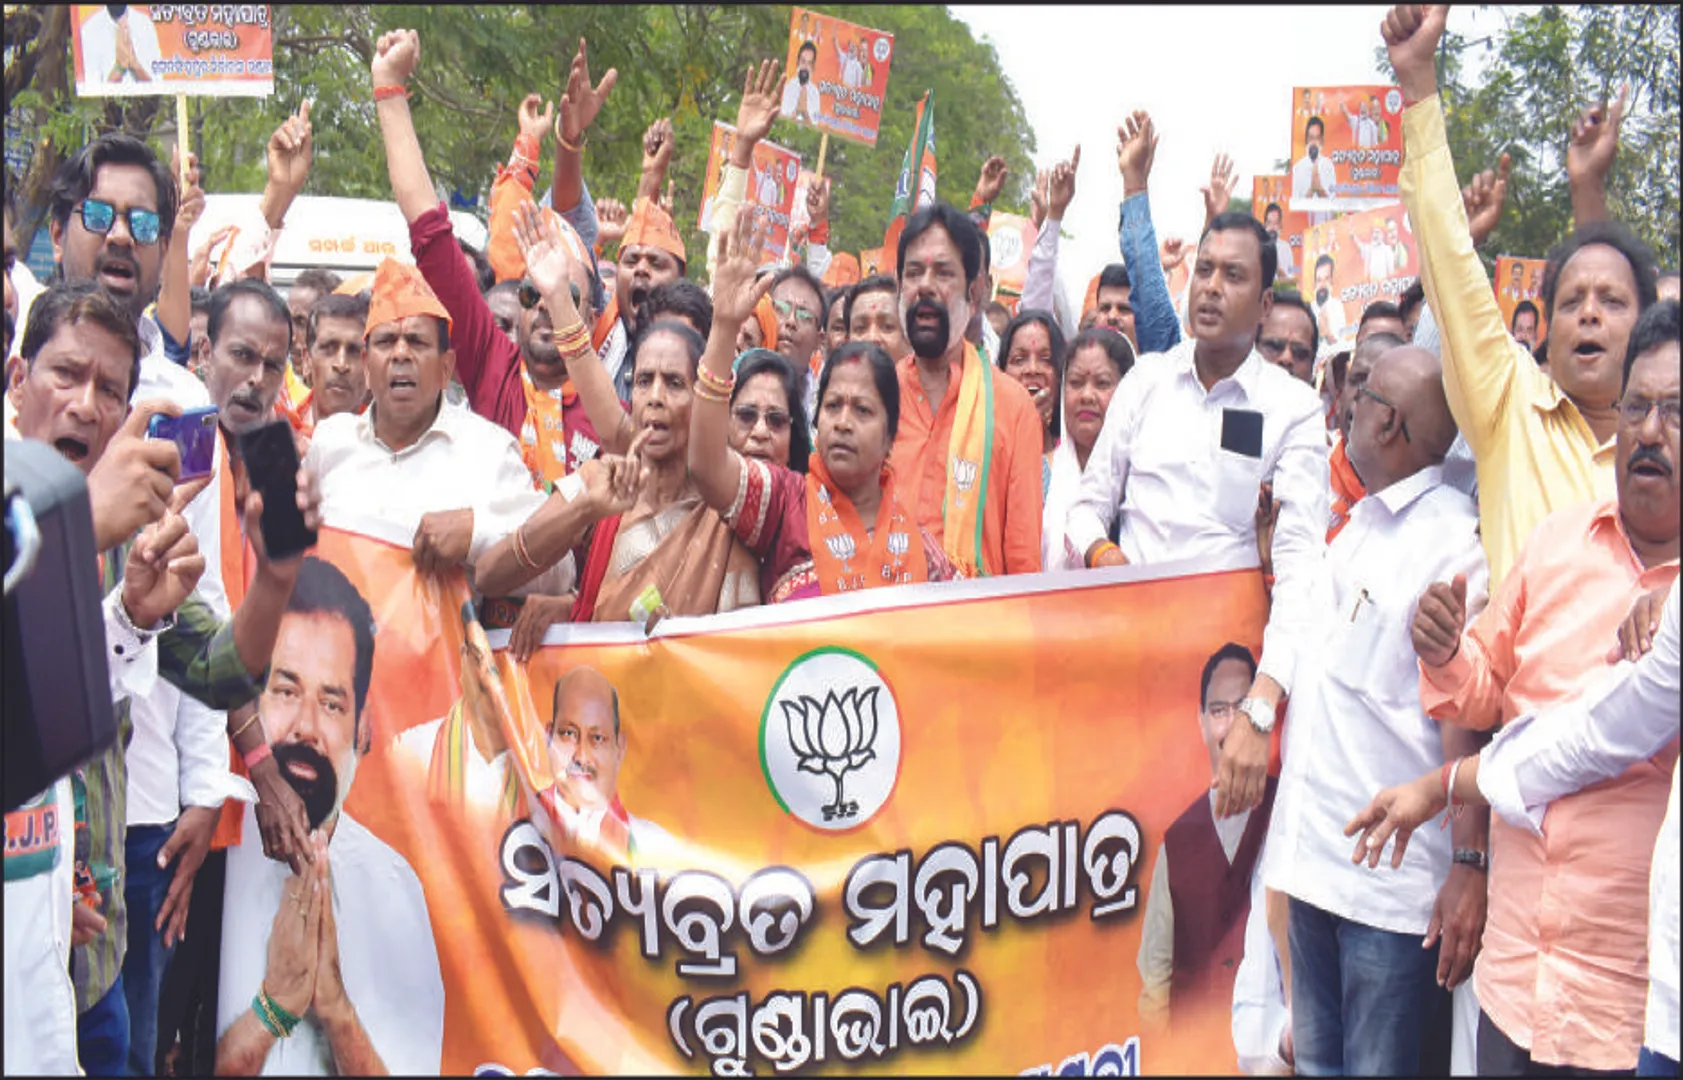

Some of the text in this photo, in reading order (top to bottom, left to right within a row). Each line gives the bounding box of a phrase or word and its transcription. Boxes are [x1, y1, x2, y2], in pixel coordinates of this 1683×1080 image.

[499, 808, 1142, 977] ସତ୍ୟବ୍ରତ ମହାପାତ୍ର
[666, 969, 981, 1077] (ଗୁଣ୍ଡାଭାଇ)
